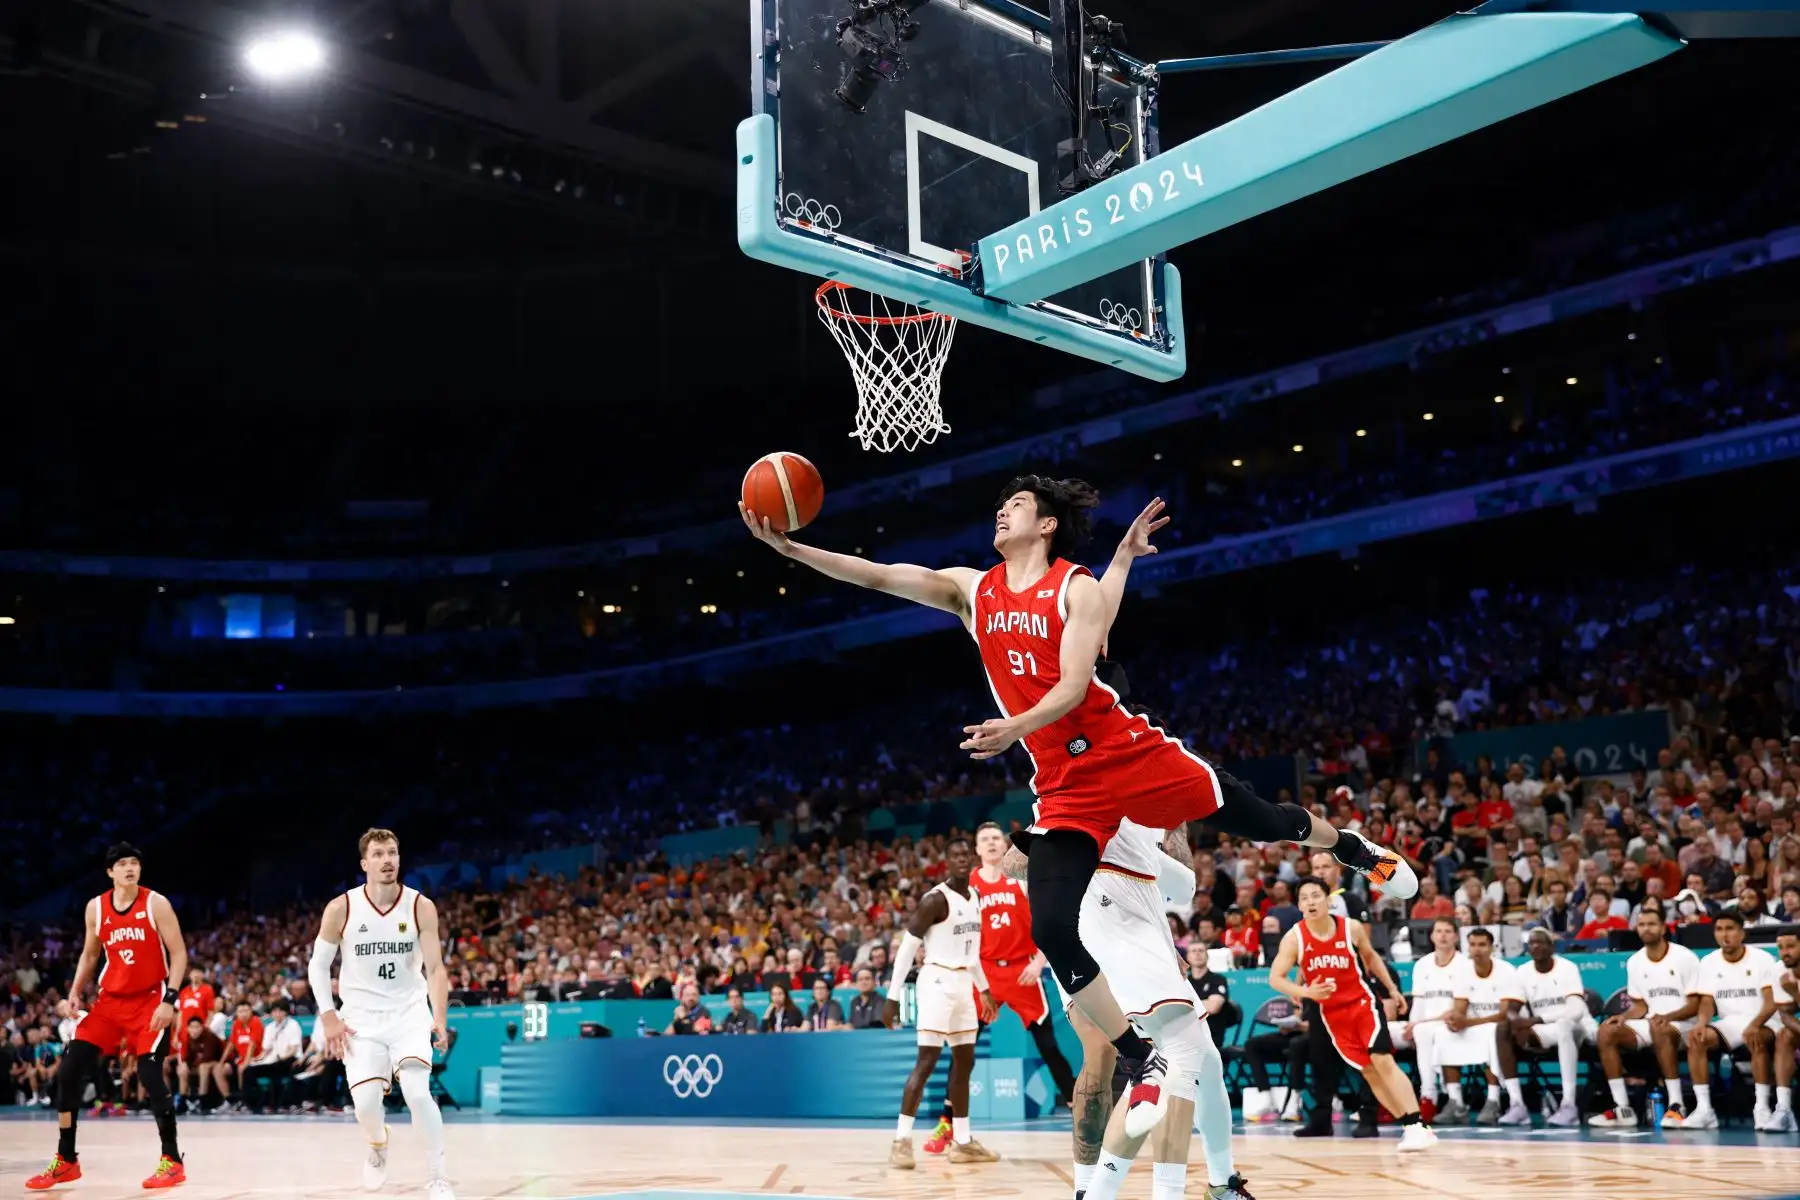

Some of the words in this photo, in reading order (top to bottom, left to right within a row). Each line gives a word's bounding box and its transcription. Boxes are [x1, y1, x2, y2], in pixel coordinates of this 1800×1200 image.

[994, 208, 1092, 275] PARIS
[1105, 161, 1204, 225] 2024
[986, 611, 1048, 639] JAPAN
[1008, 650, 1037, 676] 91
[1574, 742, 1648, 771] 024
[989, 911, 1011, 930] 24
[107, 927, 146, 946] JAPAN
[118, 949, 136, 966] 12
[355, 942, 414, 956] DEUTSCHLAND
[378, 962, 396, 980] 42
[1307, 954, 1350, 972] JAPAN
[524, 1003, 548, 1037] 33
